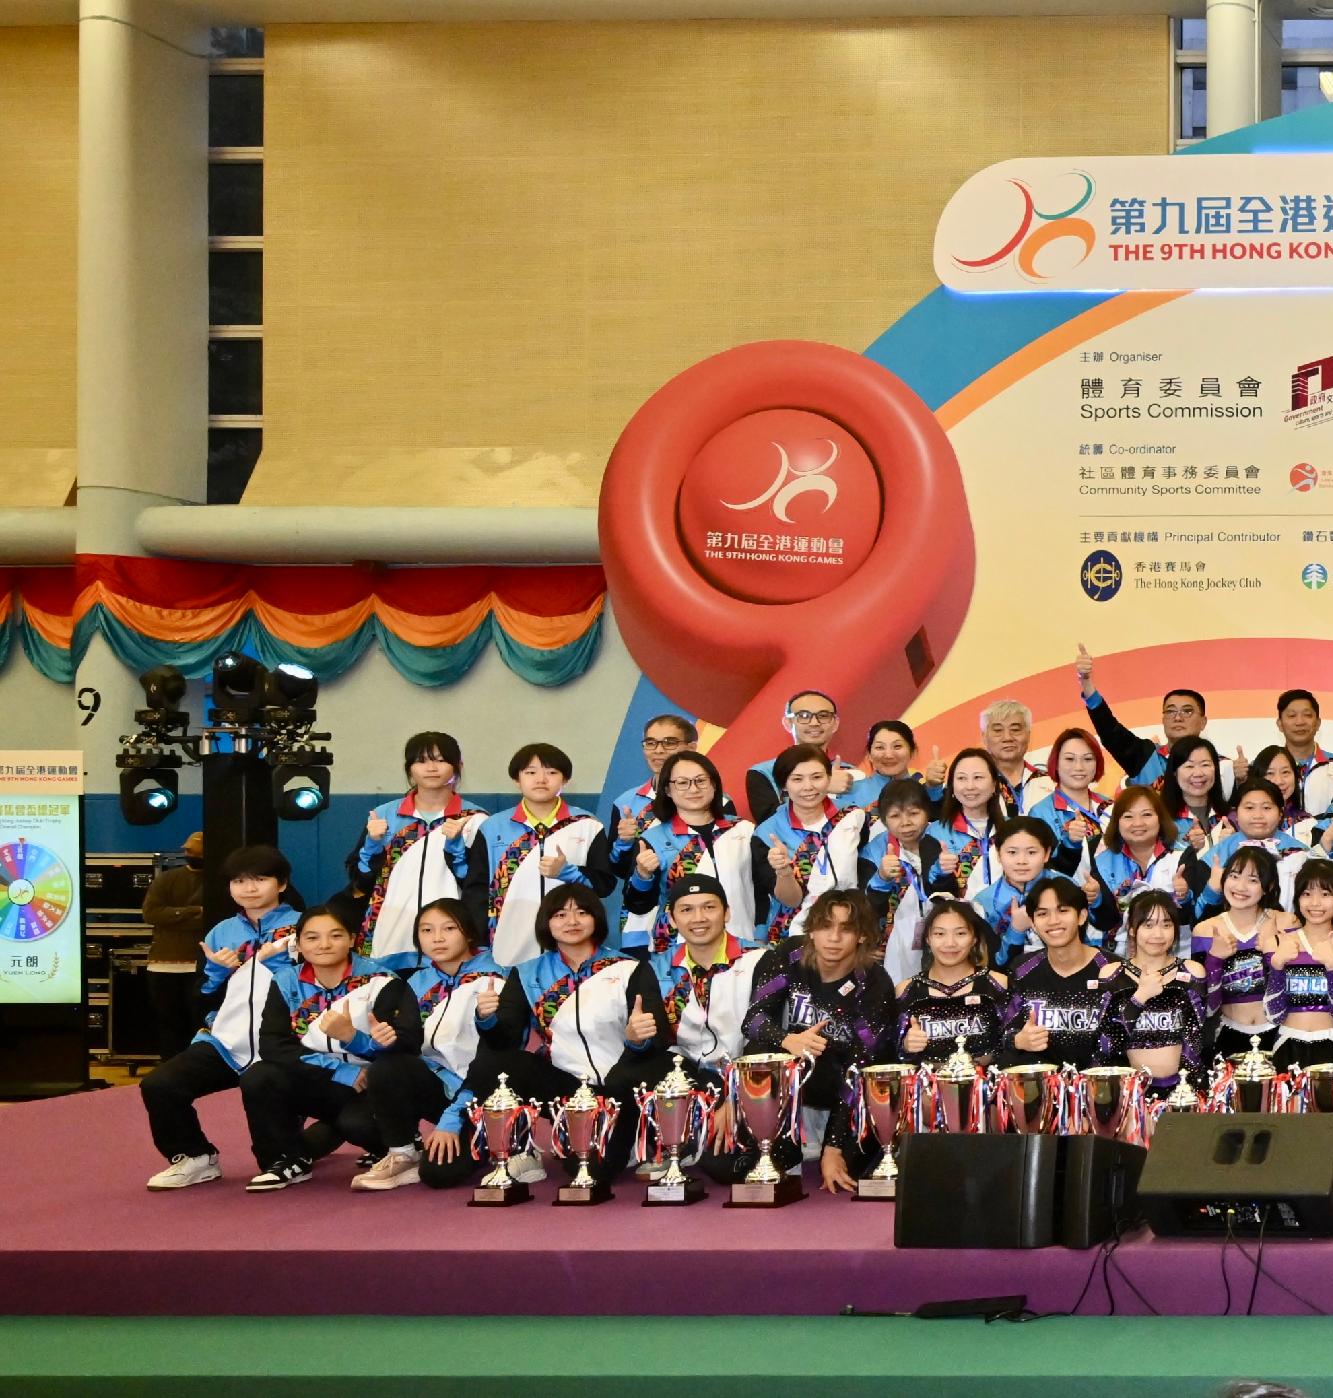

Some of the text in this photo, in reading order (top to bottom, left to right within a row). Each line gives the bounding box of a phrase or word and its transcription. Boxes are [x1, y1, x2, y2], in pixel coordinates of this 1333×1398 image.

[1109, 244, 1154, 261] THE
[1160, 243, 1205, 260] 9TH
[1212, 243, 1281, 260] HONG
[1079, 351, 1163, 363] 主辦 Organiser
[1080, 375, 1262, 399] 體育委員會
[1080, 403, 1263, 421] Sports Commission
[1284, 405, 1324, 422] Government
[1109, 444, 1176, 455] Co-ordinator
[1079, 464, 1261, 480] 社區體育事務委員會
[1079, 484, 1261, 496] Community Sports Committee
[706, 532, 844, 554] 第九屆全港運動會
[1080, 531, 1281, 544] 主要貢獻機構 Principal Contributor
[705, 551, 844, 565] THE 9TH HONG KONG GAMES
[1134, 561, 1206, 573] 香港賽馬會
[1134, 577, 1261, 591] The Hong Kong Jockey Club
[77, 687, 101, 726] 9
[11, 955, 38, 967] 元朗
[1029, 998, 1100, 1031] JENGA
[919, 1013, 985, 1038] JENGA
